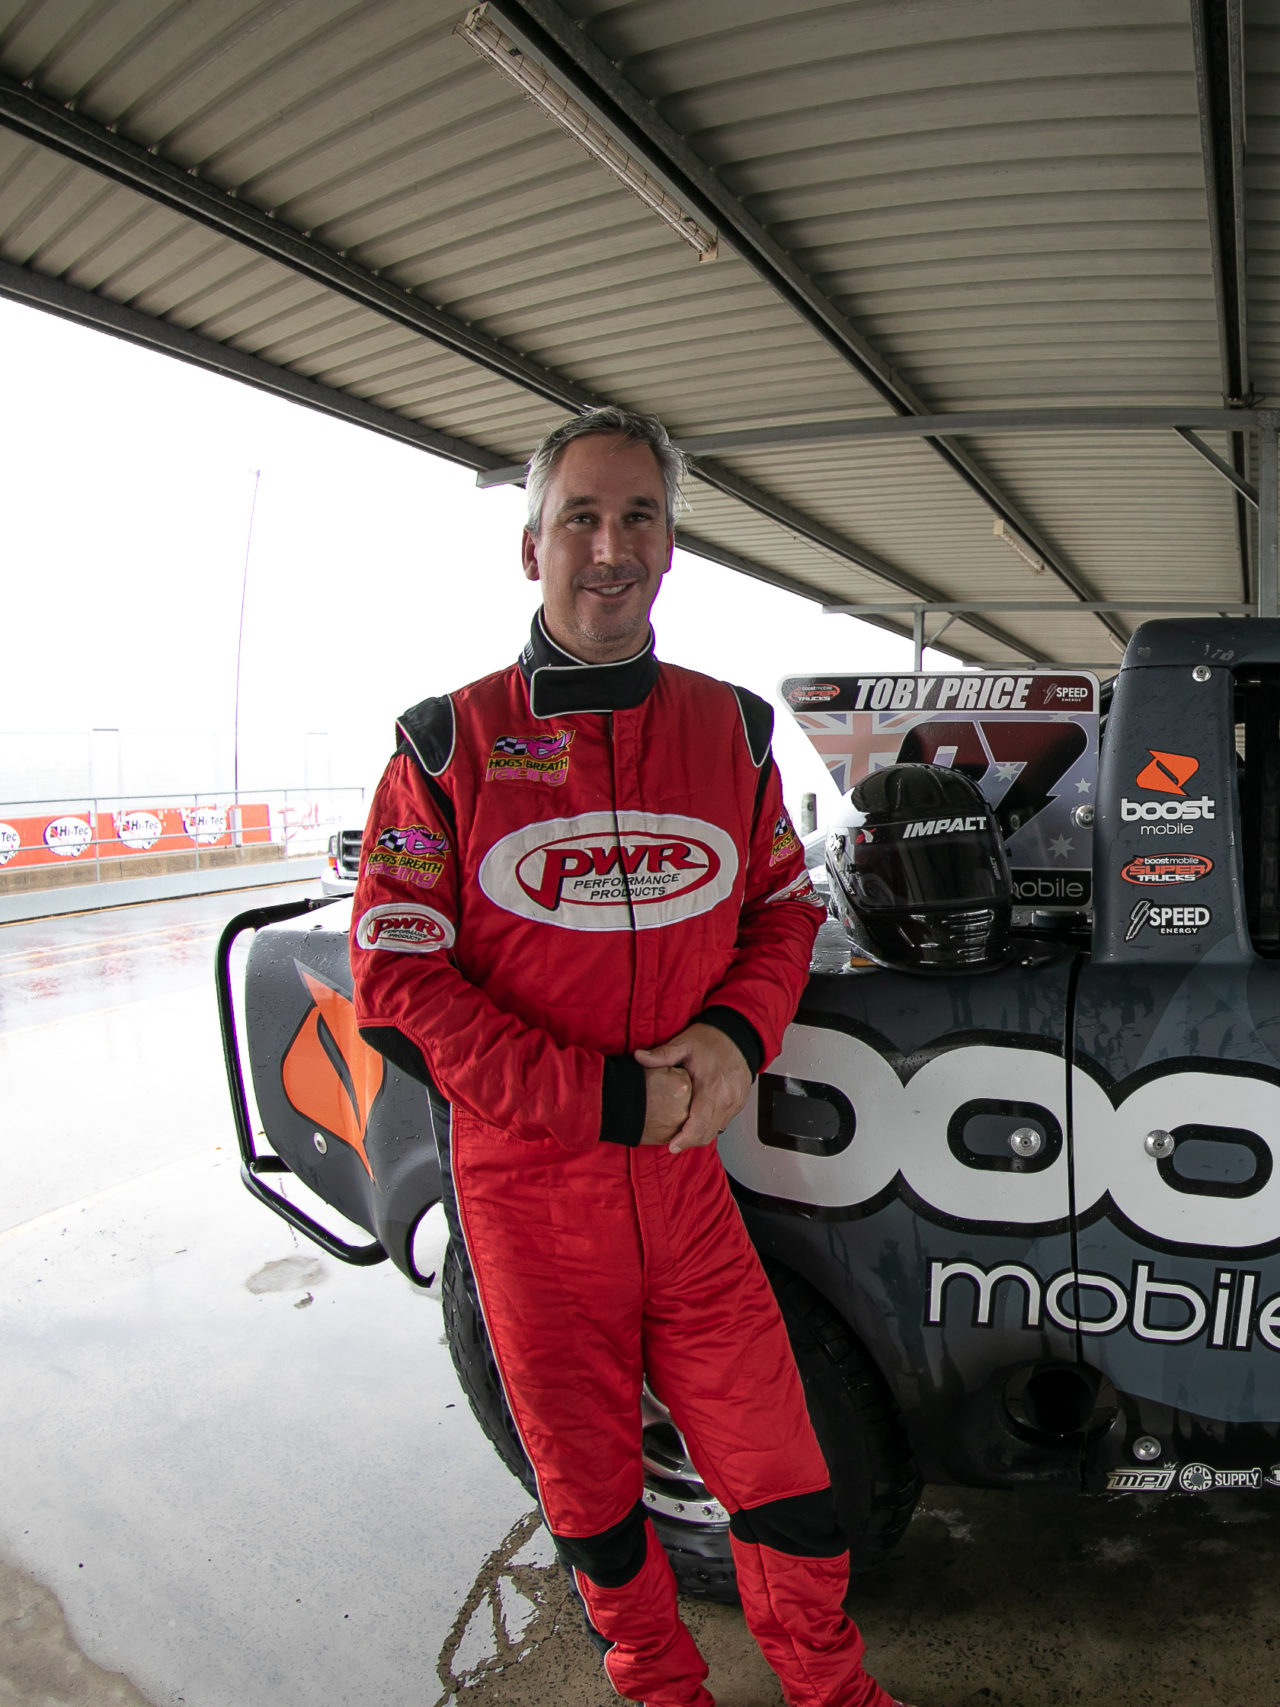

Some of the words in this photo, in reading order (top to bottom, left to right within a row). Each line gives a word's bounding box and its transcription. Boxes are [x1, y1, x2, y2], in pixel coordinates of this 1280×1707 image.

[854, 677, 938, 711] TOBY
[935, 676, 1034, 711] PRICE
[1056, 687, 1089, 698] SPEED
[525, 756, 569, 773] BREATH
[485, 766, 567, 787] racing
[1121, 795, 1216, 822] boost
[59, 825, 89, 838] Hi-Tec
[902, 815, 987, 840] IMPACT
[1140, 822, 1195, 836] mobile
[398, 856, 443, 874] BREATH
[1129, 864, 1207, 876] SUPER
[540, 842, 709, 912] PWR
[573, 872, 681, 890] PERFORMANCE
[1136, 874, 1196, 882] TRUCKS
[590, 886, 667, 901] PRODUCTS
[1149, 906, 1210, 927] SPEED
[366, 917, 443, 945] PWR
[1160, 927, 1198, 935] ENERGY
[1215, 1472, 1260, 1487] SUPPLY
